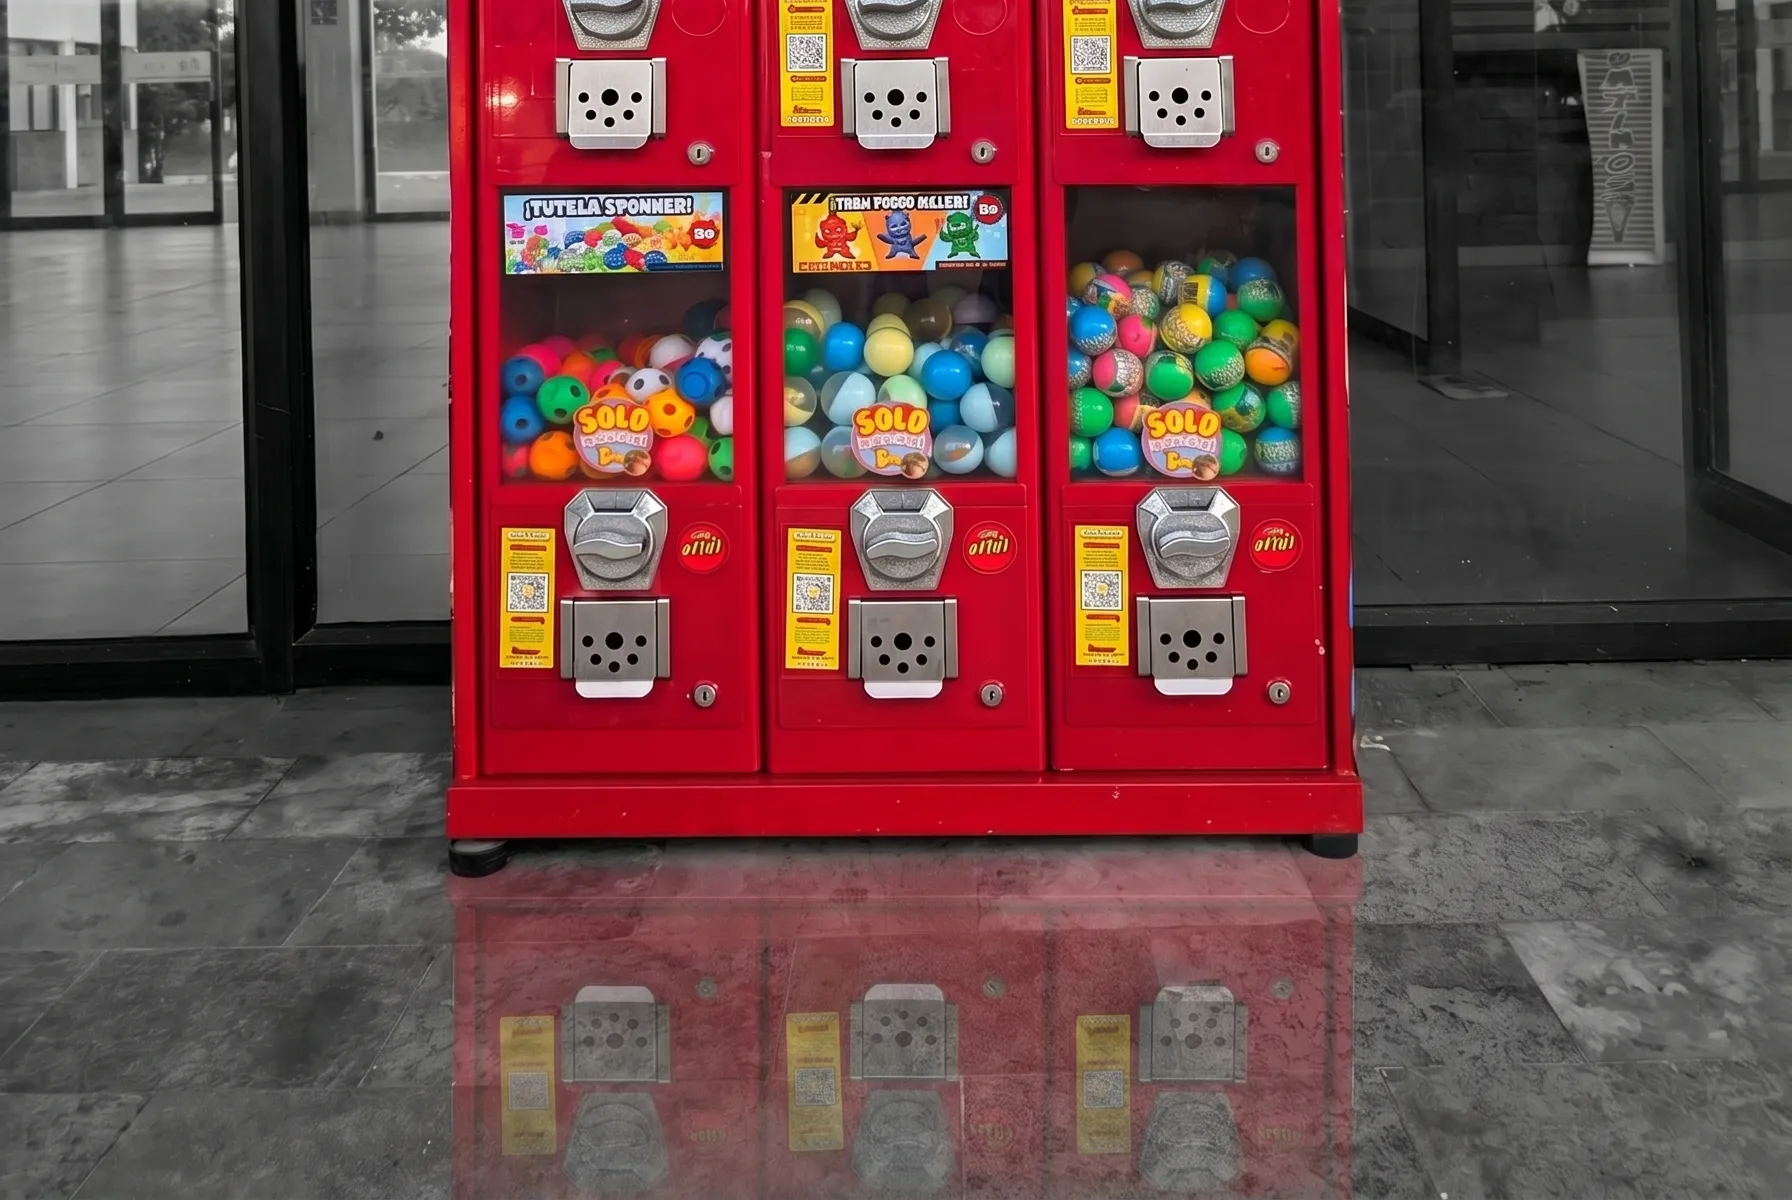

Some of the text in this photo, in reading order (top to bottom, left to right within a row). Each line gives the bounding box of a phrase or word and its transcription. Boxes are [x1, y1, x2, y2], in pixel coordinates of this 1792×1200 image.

[577, 403, 650, 435] SOLO
[854, 405, 929, 436] SOLO
[1146, 407, 1220, 439] SOLO
